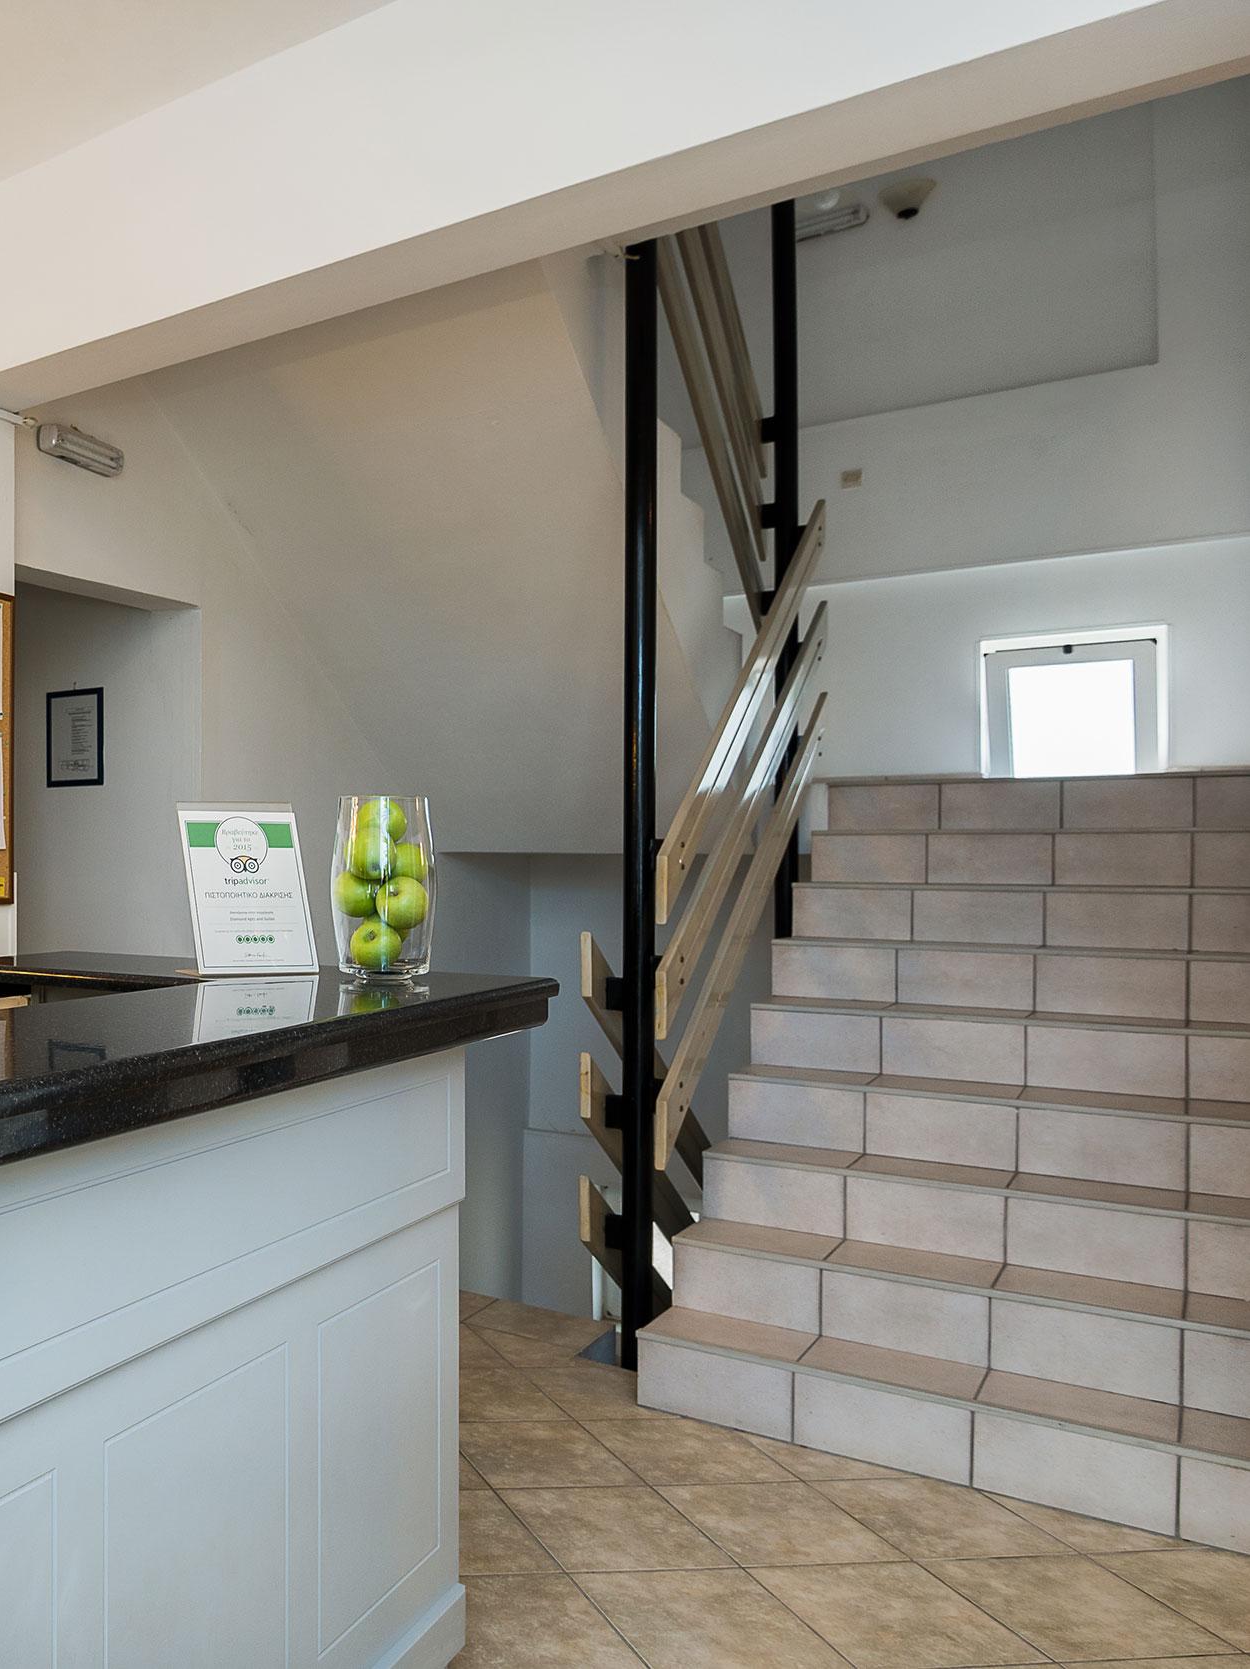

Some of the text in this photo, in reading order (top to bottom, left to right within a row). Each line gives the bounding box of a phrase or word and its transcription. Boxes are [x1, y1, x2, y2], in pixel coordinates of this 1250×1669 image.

[233, 843, 252, 851] 2015
[224, 876, 268, 886] tripadvisor
[204, 891, 293, 899] ΠΙΣΤΟΠΟΙΗΤΙΚΟ ΔΙΑΚΡΙΣΗΣ
